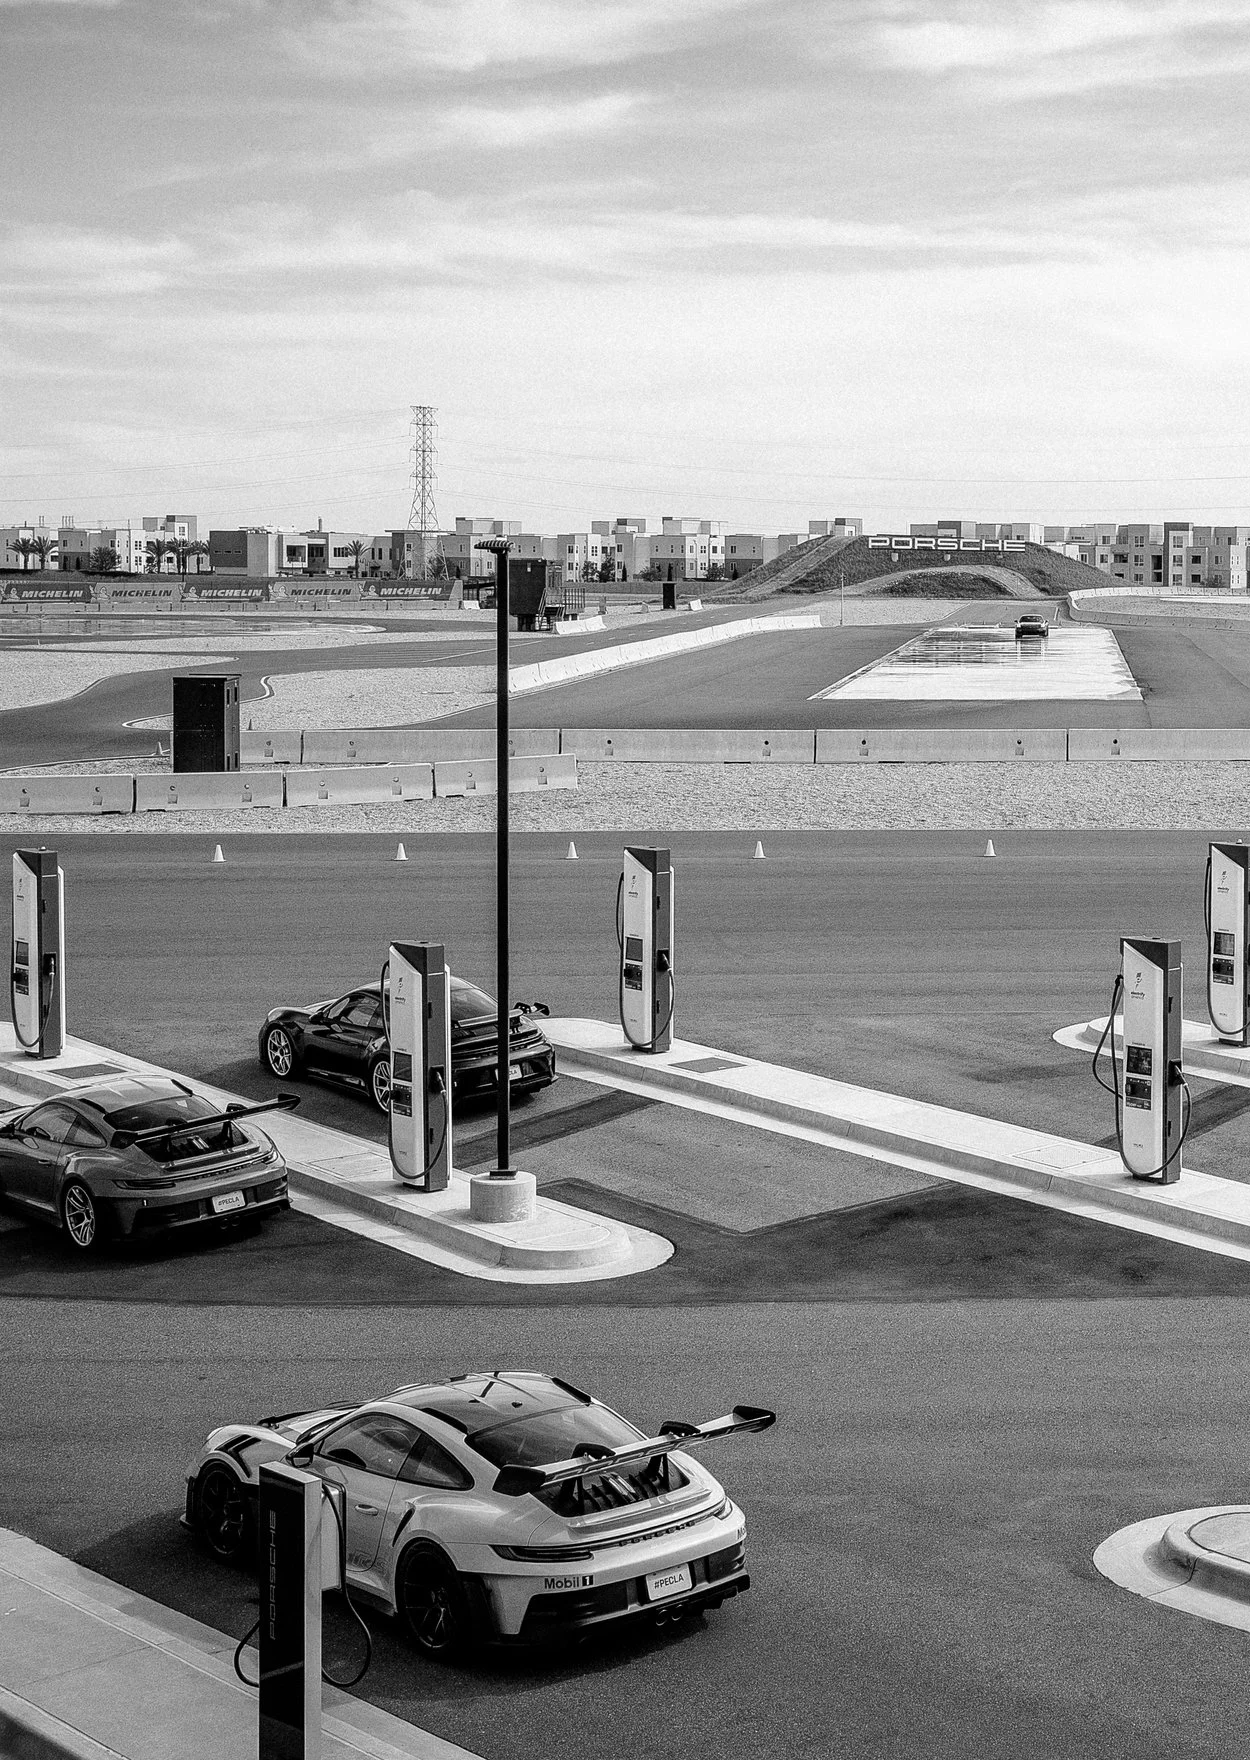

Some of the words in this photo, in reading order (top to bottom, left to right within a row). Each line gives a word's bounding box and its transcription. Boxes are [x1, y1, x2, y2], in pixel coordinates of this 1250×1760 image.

[868, 536, 1026, 552] PORSCHE
[21, 589, 84, 598] MICHELIN
[111, 589, 173, 598] MICHELIN
[200, 588, 263, 597] MICHELIN
[290, 588, 352, 596] MICHELIN
[379, 587, 443, 596] MICHELIN
[544, 1576, 580, 1589] Mobil
[583, 1575, 592, 1587] 1
[653, 1573, 685, 1590] #PECLA
